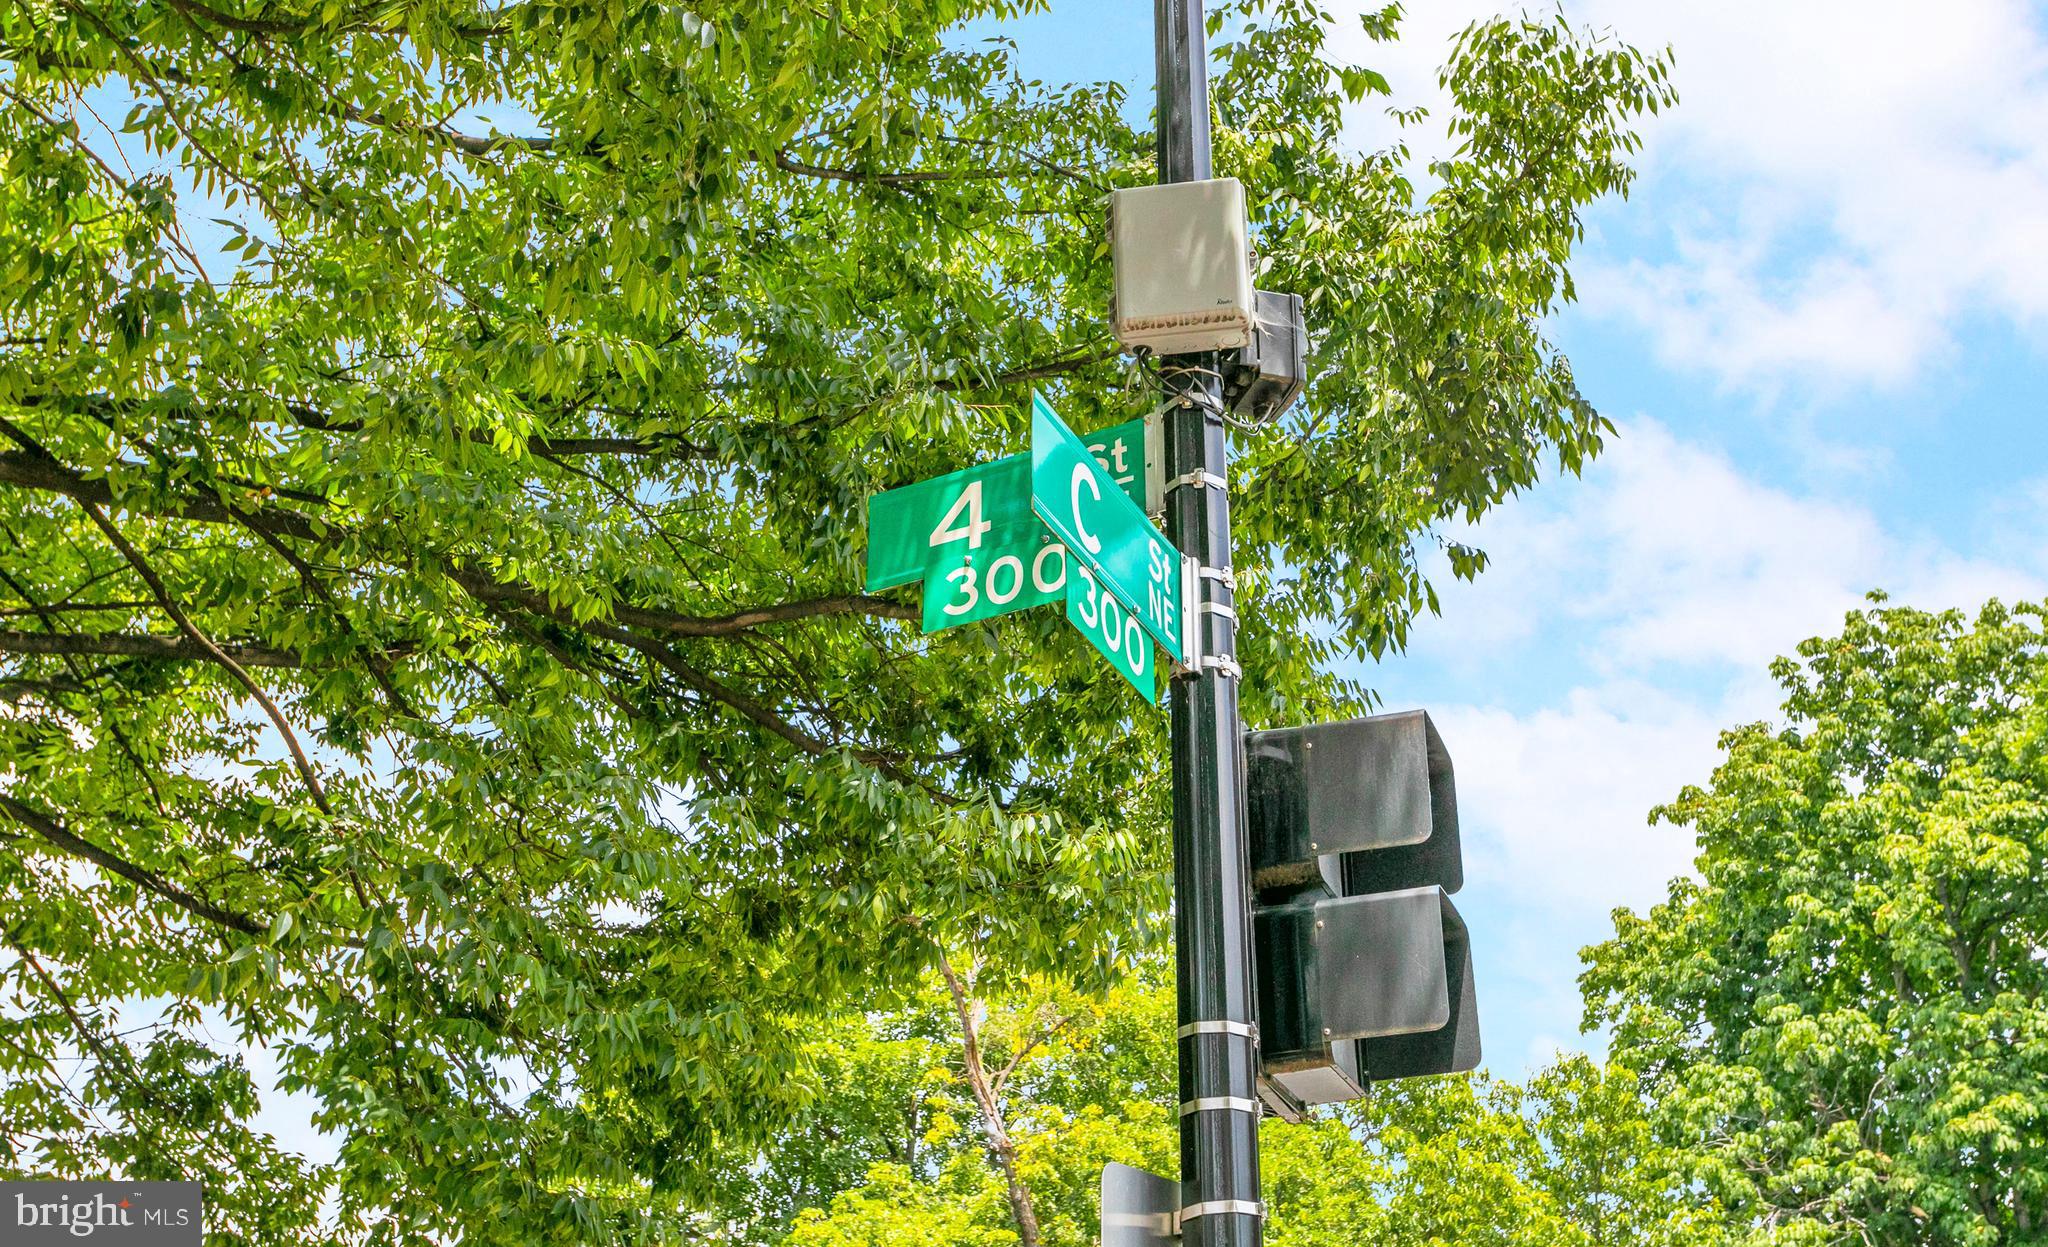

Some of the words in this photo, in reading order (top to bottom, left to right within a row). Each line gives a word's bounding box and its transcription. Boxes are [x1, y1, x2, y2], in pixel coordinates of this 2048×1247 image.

[929, 480, 992, 550] 4
[1087, 437, 1129, 474] St
[1070, 462, 1102, 555] C
[942, 543, 1066, 616] 300
[1148, 538, 1172, 596] St
[1078, 565, 1145, 676] 300
[1148, 580, 1177, 644] NE
